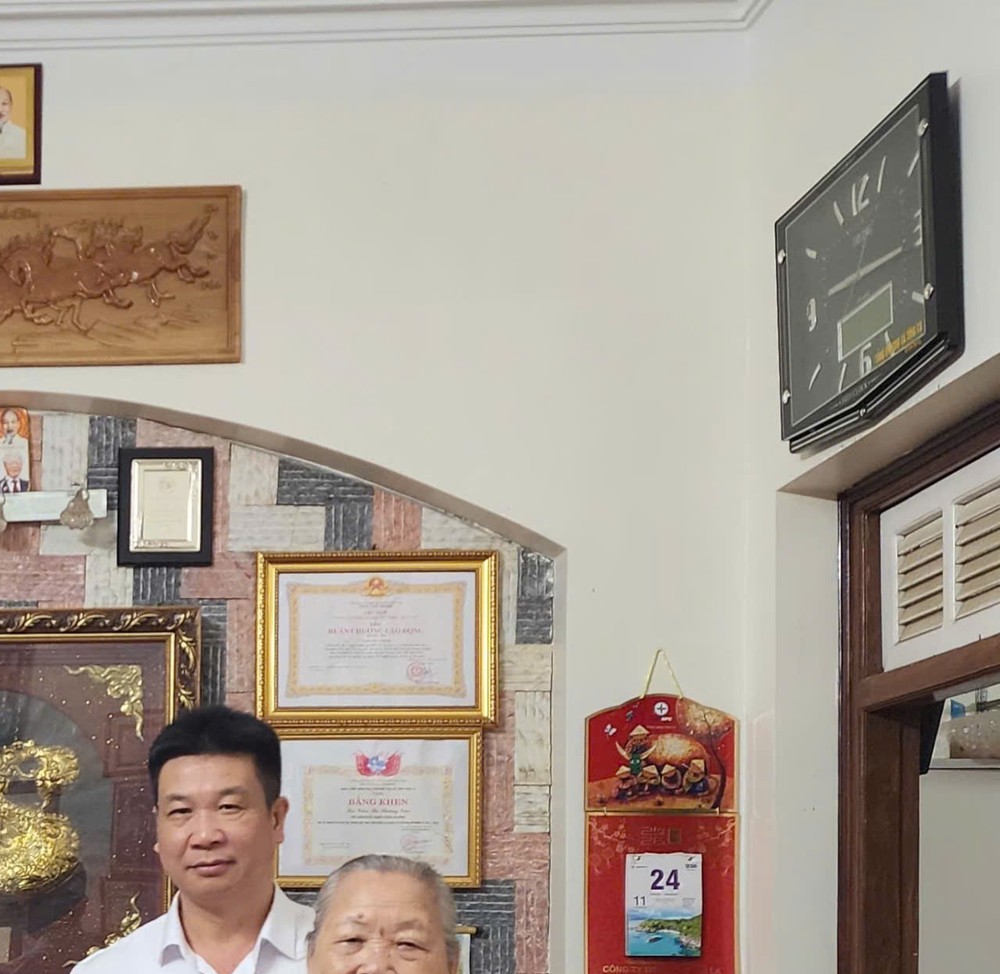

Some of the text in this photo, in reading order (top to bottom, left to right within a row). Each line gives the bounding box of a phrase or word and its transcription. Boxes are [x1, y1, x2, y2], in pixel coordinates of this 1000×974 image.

[851, 172, 870, 216] 12
[806, 297, 818, 333] 9
[650, 869, 680, 890] 24
[633, 896, 646, 906] 11
